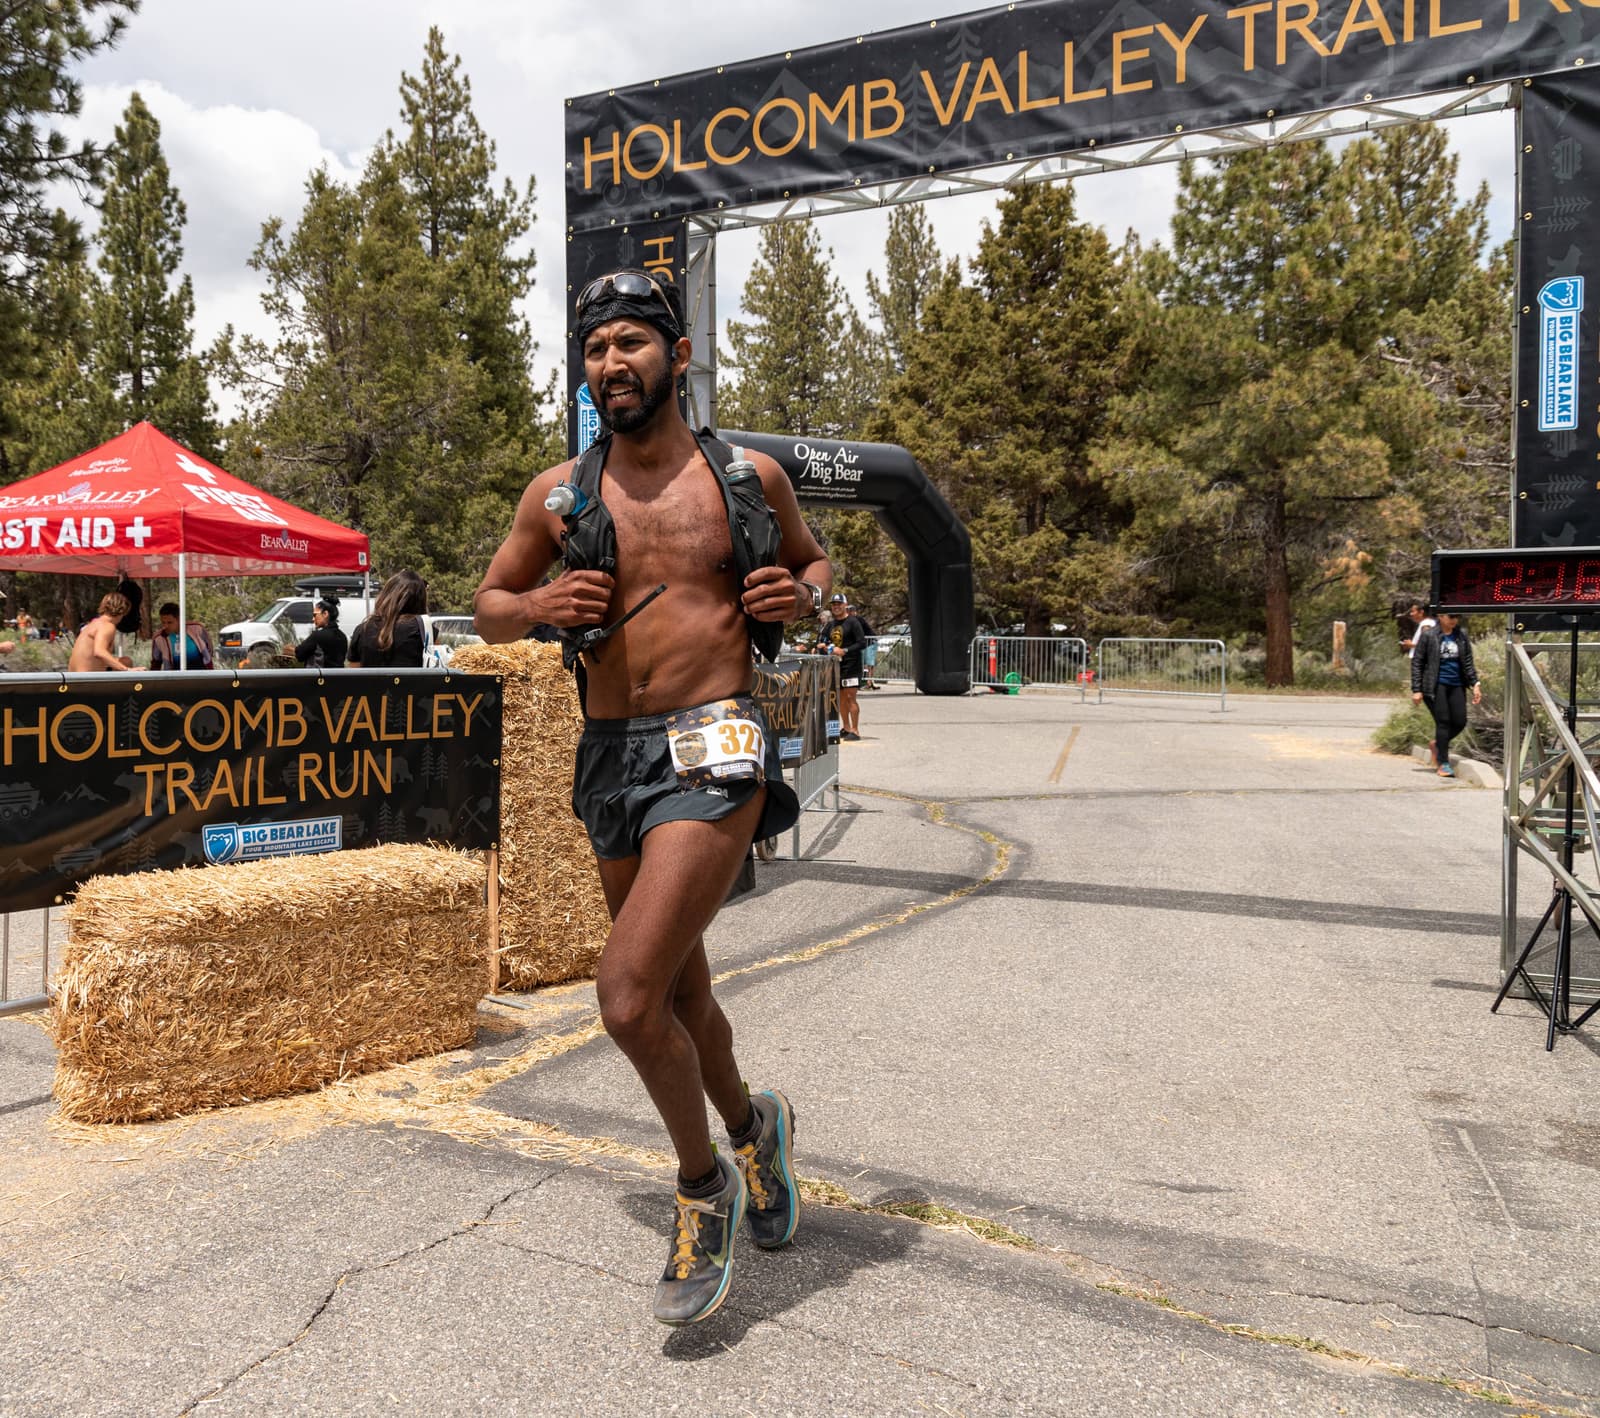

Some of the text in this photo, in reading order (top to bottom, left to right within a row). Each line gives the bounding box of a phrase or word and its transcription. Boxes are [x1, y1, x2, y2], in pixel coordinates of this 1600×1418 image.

[583, 0, 1482, 189] HOLCOMB VALLEY TRAIL
[1557, 315, 1573, 423] BIG BEAR LAKE
[589, 409, 597, 428] BIG
[794, 443, 859, 478] Open Air
[810, 461, 863, 485] Big Bear
[181, 483, 273, 512] FIRST
[231, 505, 288, 526] AID
[55, 516, 116, 548] AID
[3, 692, 484, 765] HOLCOMB VALLEY
[133, 747, 392, 816] TRAIL RUN
[242, 821, 337, 844] BIG BEAR LAKE
[245, 837, 335, 853] YOUR MOUNTAIN LAKE ESCAPE
